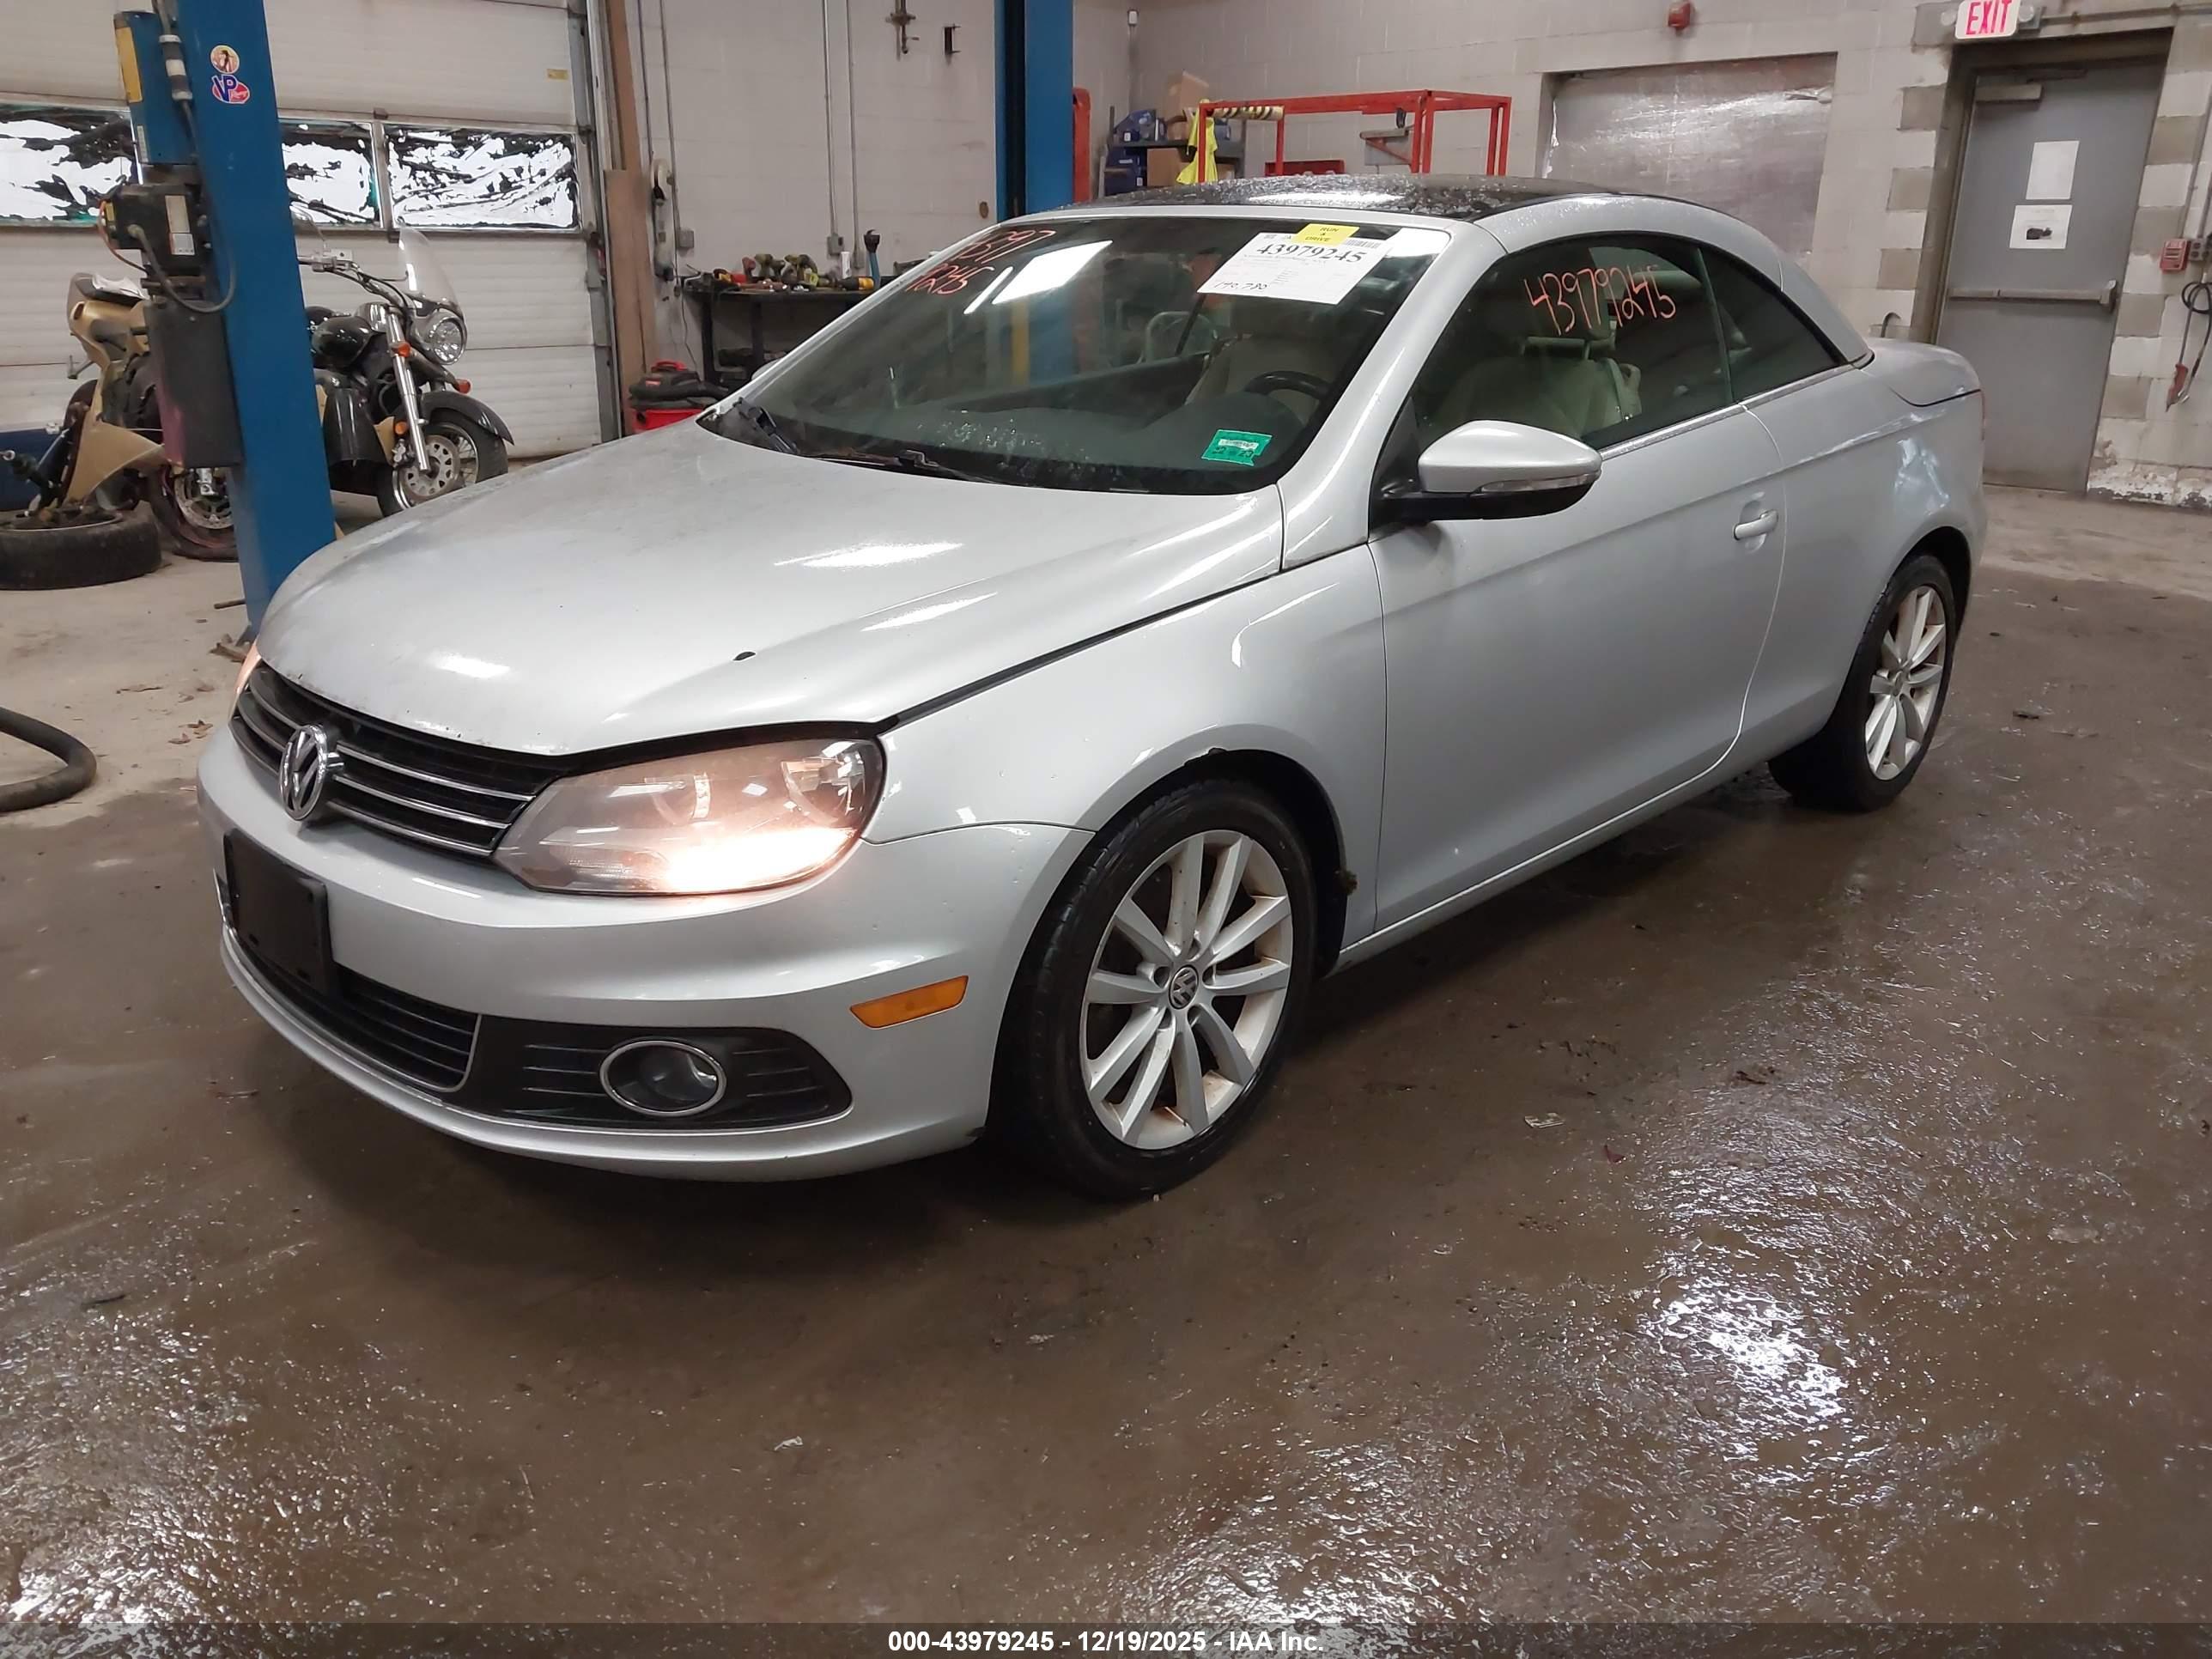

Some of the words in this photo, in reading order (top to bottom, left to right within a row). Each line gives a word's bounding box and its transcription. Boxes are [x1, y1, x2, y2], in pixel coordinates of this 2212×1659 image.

[1966, 0, 2012, 35] EXIT
[211, 75, 238, 102] VP
[1256, 243, 1368, 263] 43979245
[1523, 264, 1676, 336] 43979245
